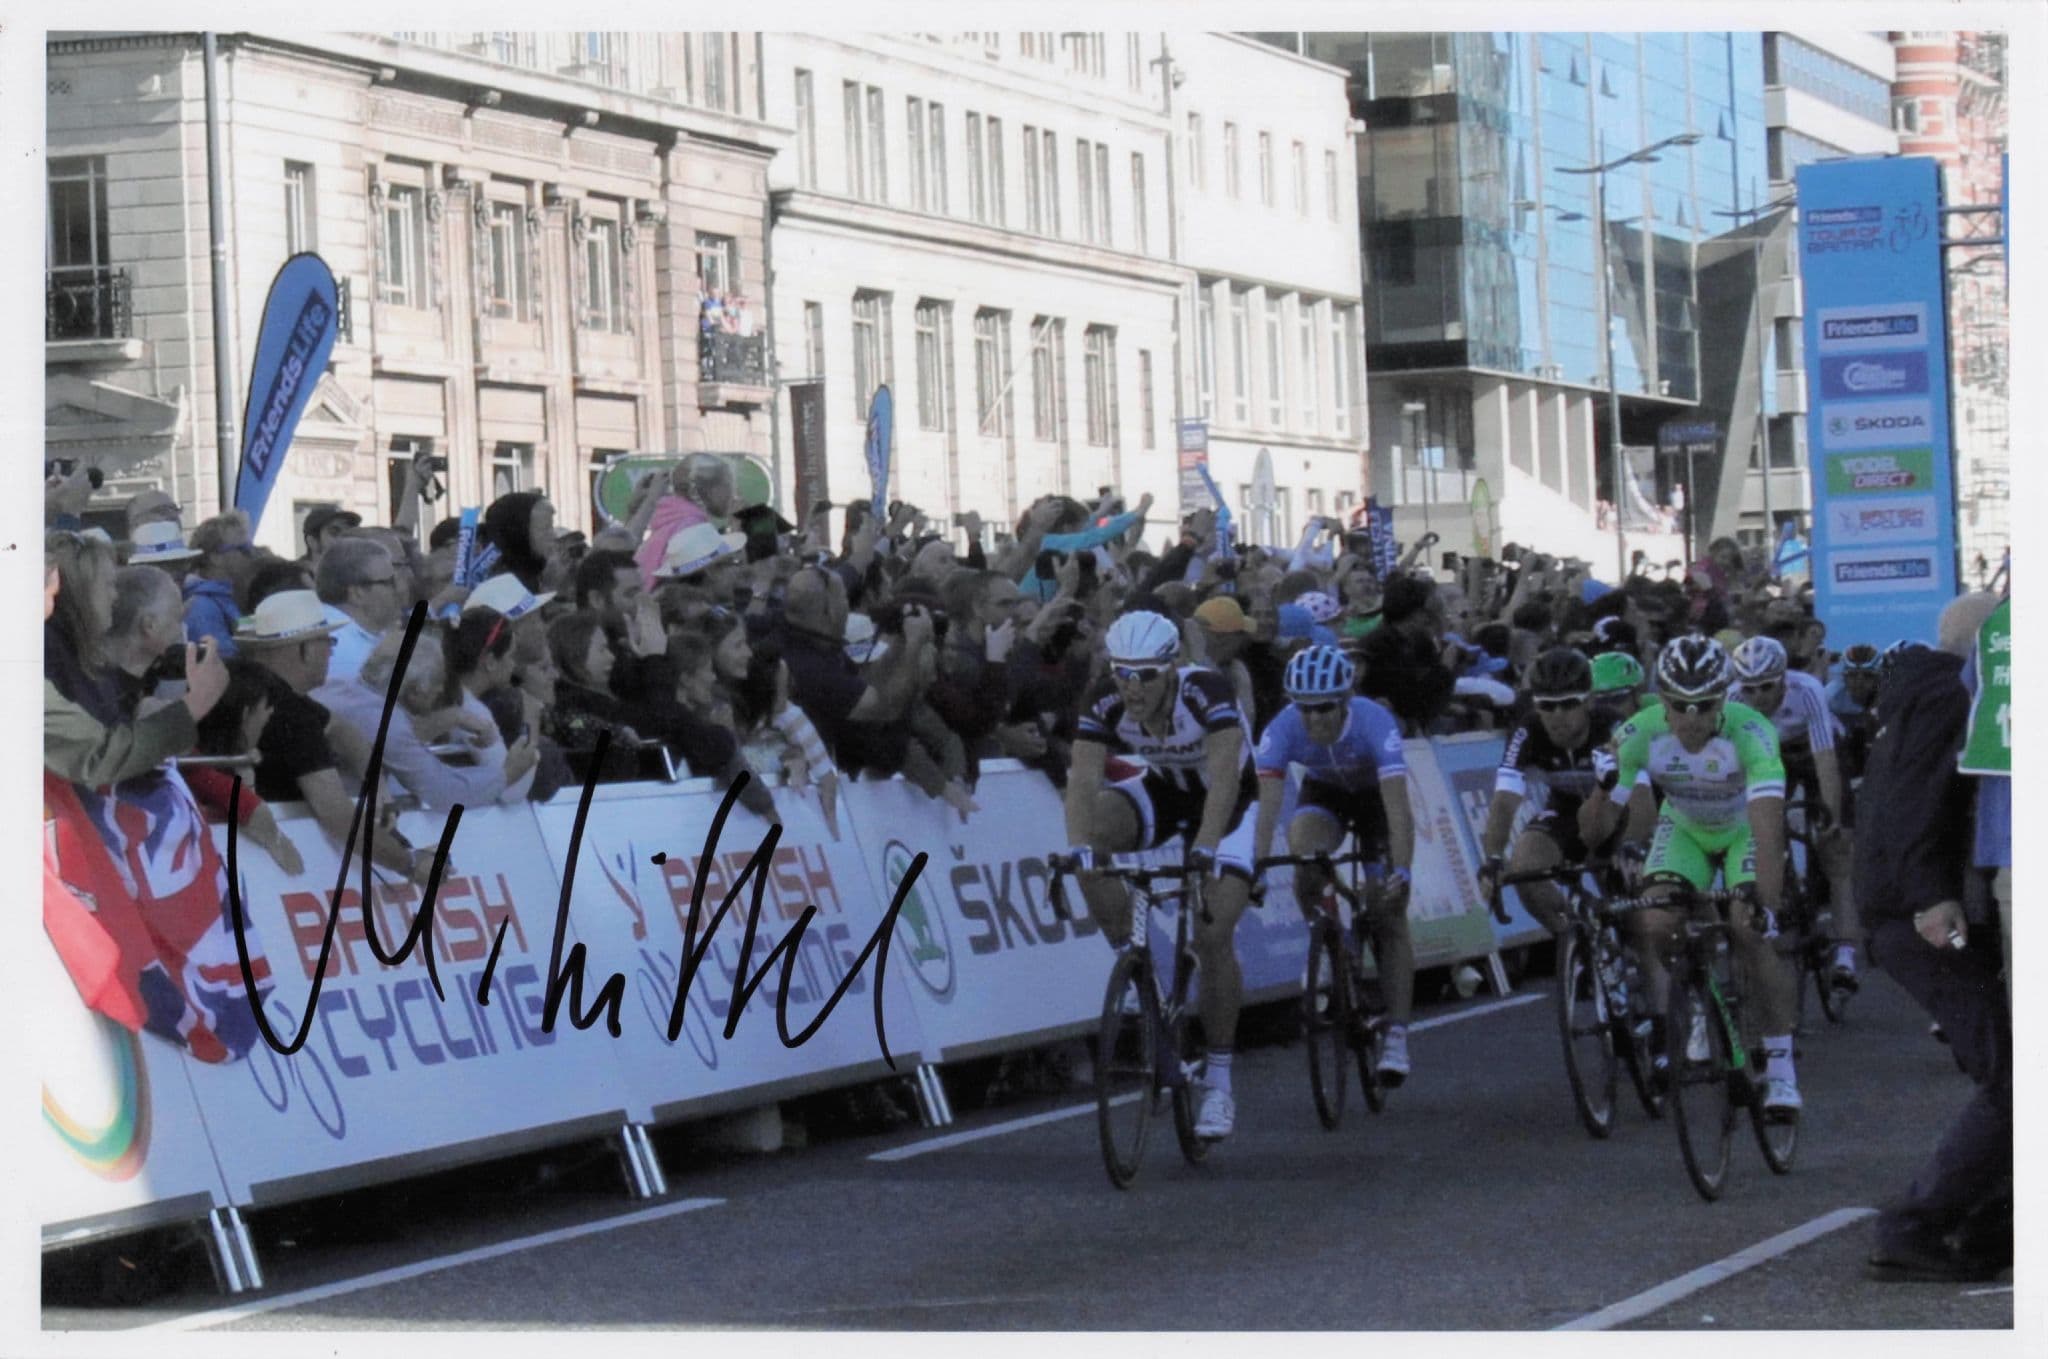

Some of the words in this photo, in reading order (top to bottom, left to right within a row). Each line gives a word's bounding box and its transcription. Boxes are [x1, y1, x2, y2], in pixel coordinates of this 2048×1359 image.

[1853, 471, 1909, 488] DIRECT
[280, 872, 529, 982] BRITISH
[661, 843, 843, 934] BRITISH
[317, 963, 558, 1079] CYCLING
